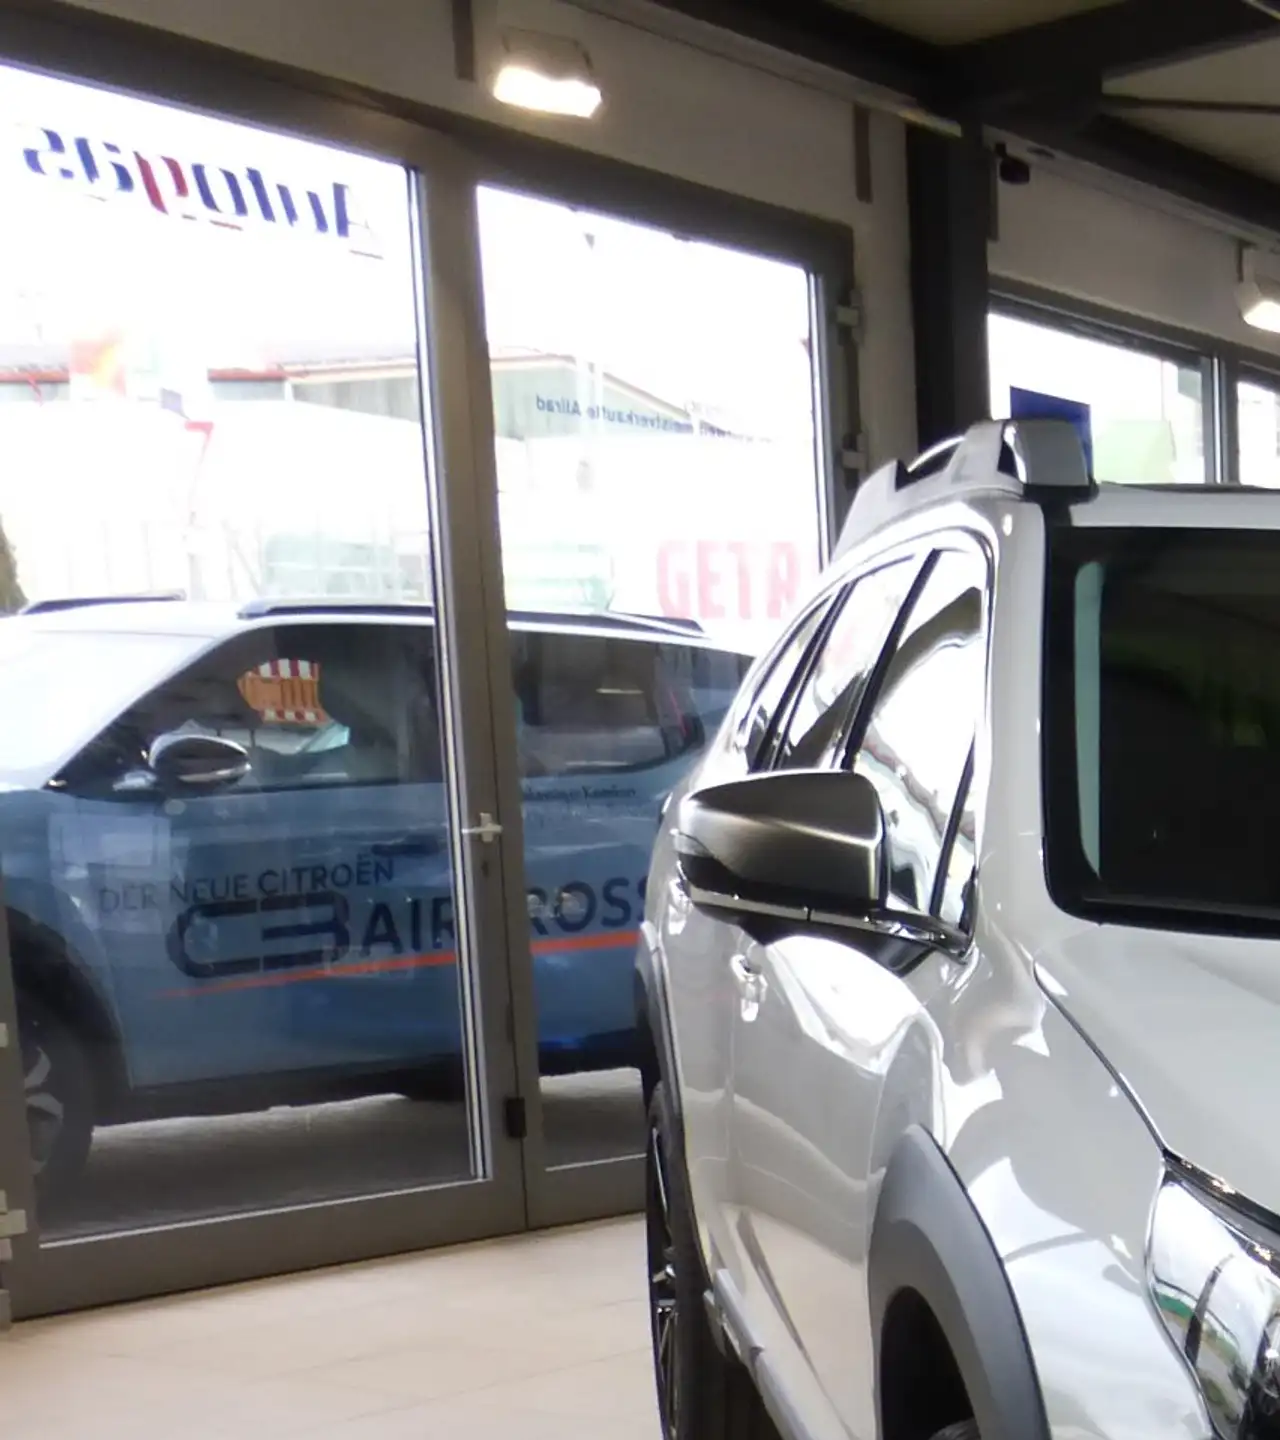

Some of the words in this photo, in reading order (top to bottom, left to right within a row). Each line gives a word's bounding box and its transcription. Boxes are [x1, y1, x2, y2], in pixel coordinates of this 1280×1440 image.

[169, 873, 249, 903] NEUE
[257, 852, 396, 896] CITROËN
[360, 879, 646, 958] AIRROS
